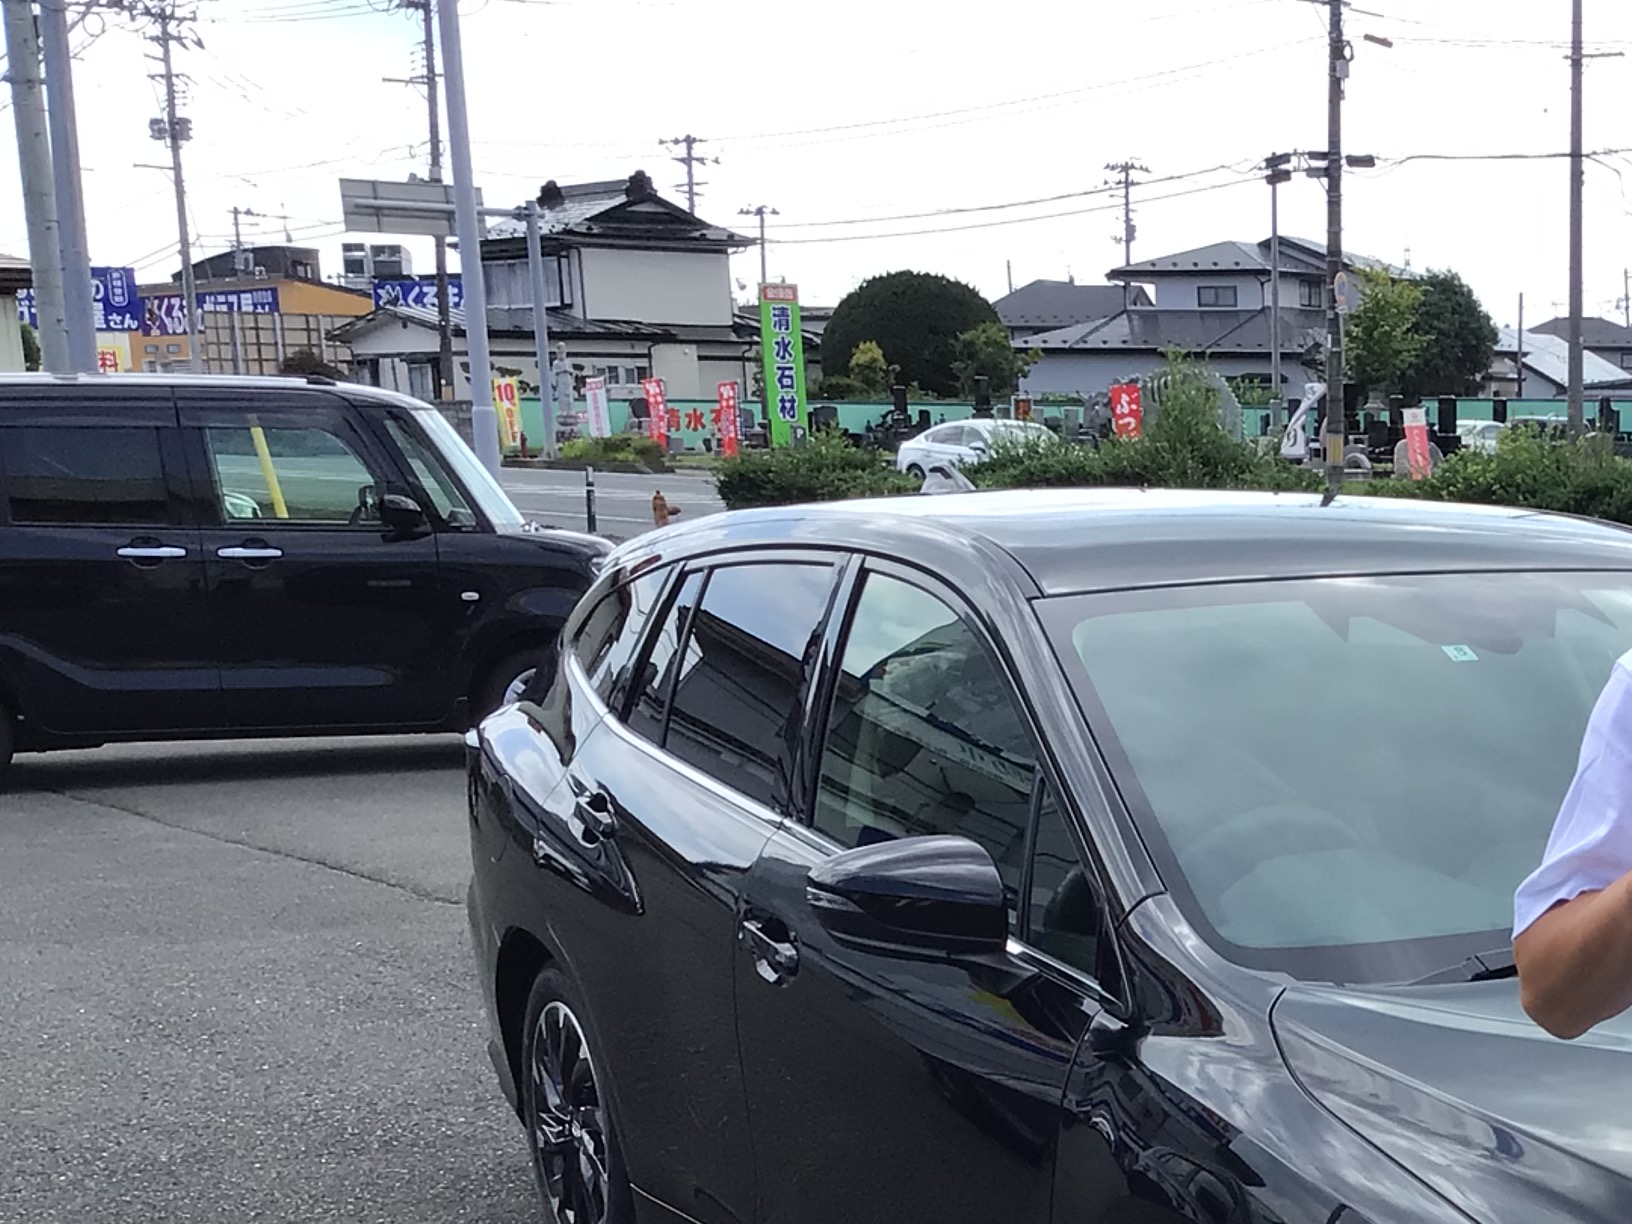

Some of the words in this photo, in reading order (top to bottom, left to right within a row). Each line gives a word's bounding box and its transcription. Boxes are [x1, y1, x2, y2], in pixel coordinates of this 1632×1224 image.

[407, 285, 465, 308] くるま
[771, 305, 797, 420] 清水石材
[1116, 392, 1138, 438] ぶつ
[796, 428, 804, 439] P
